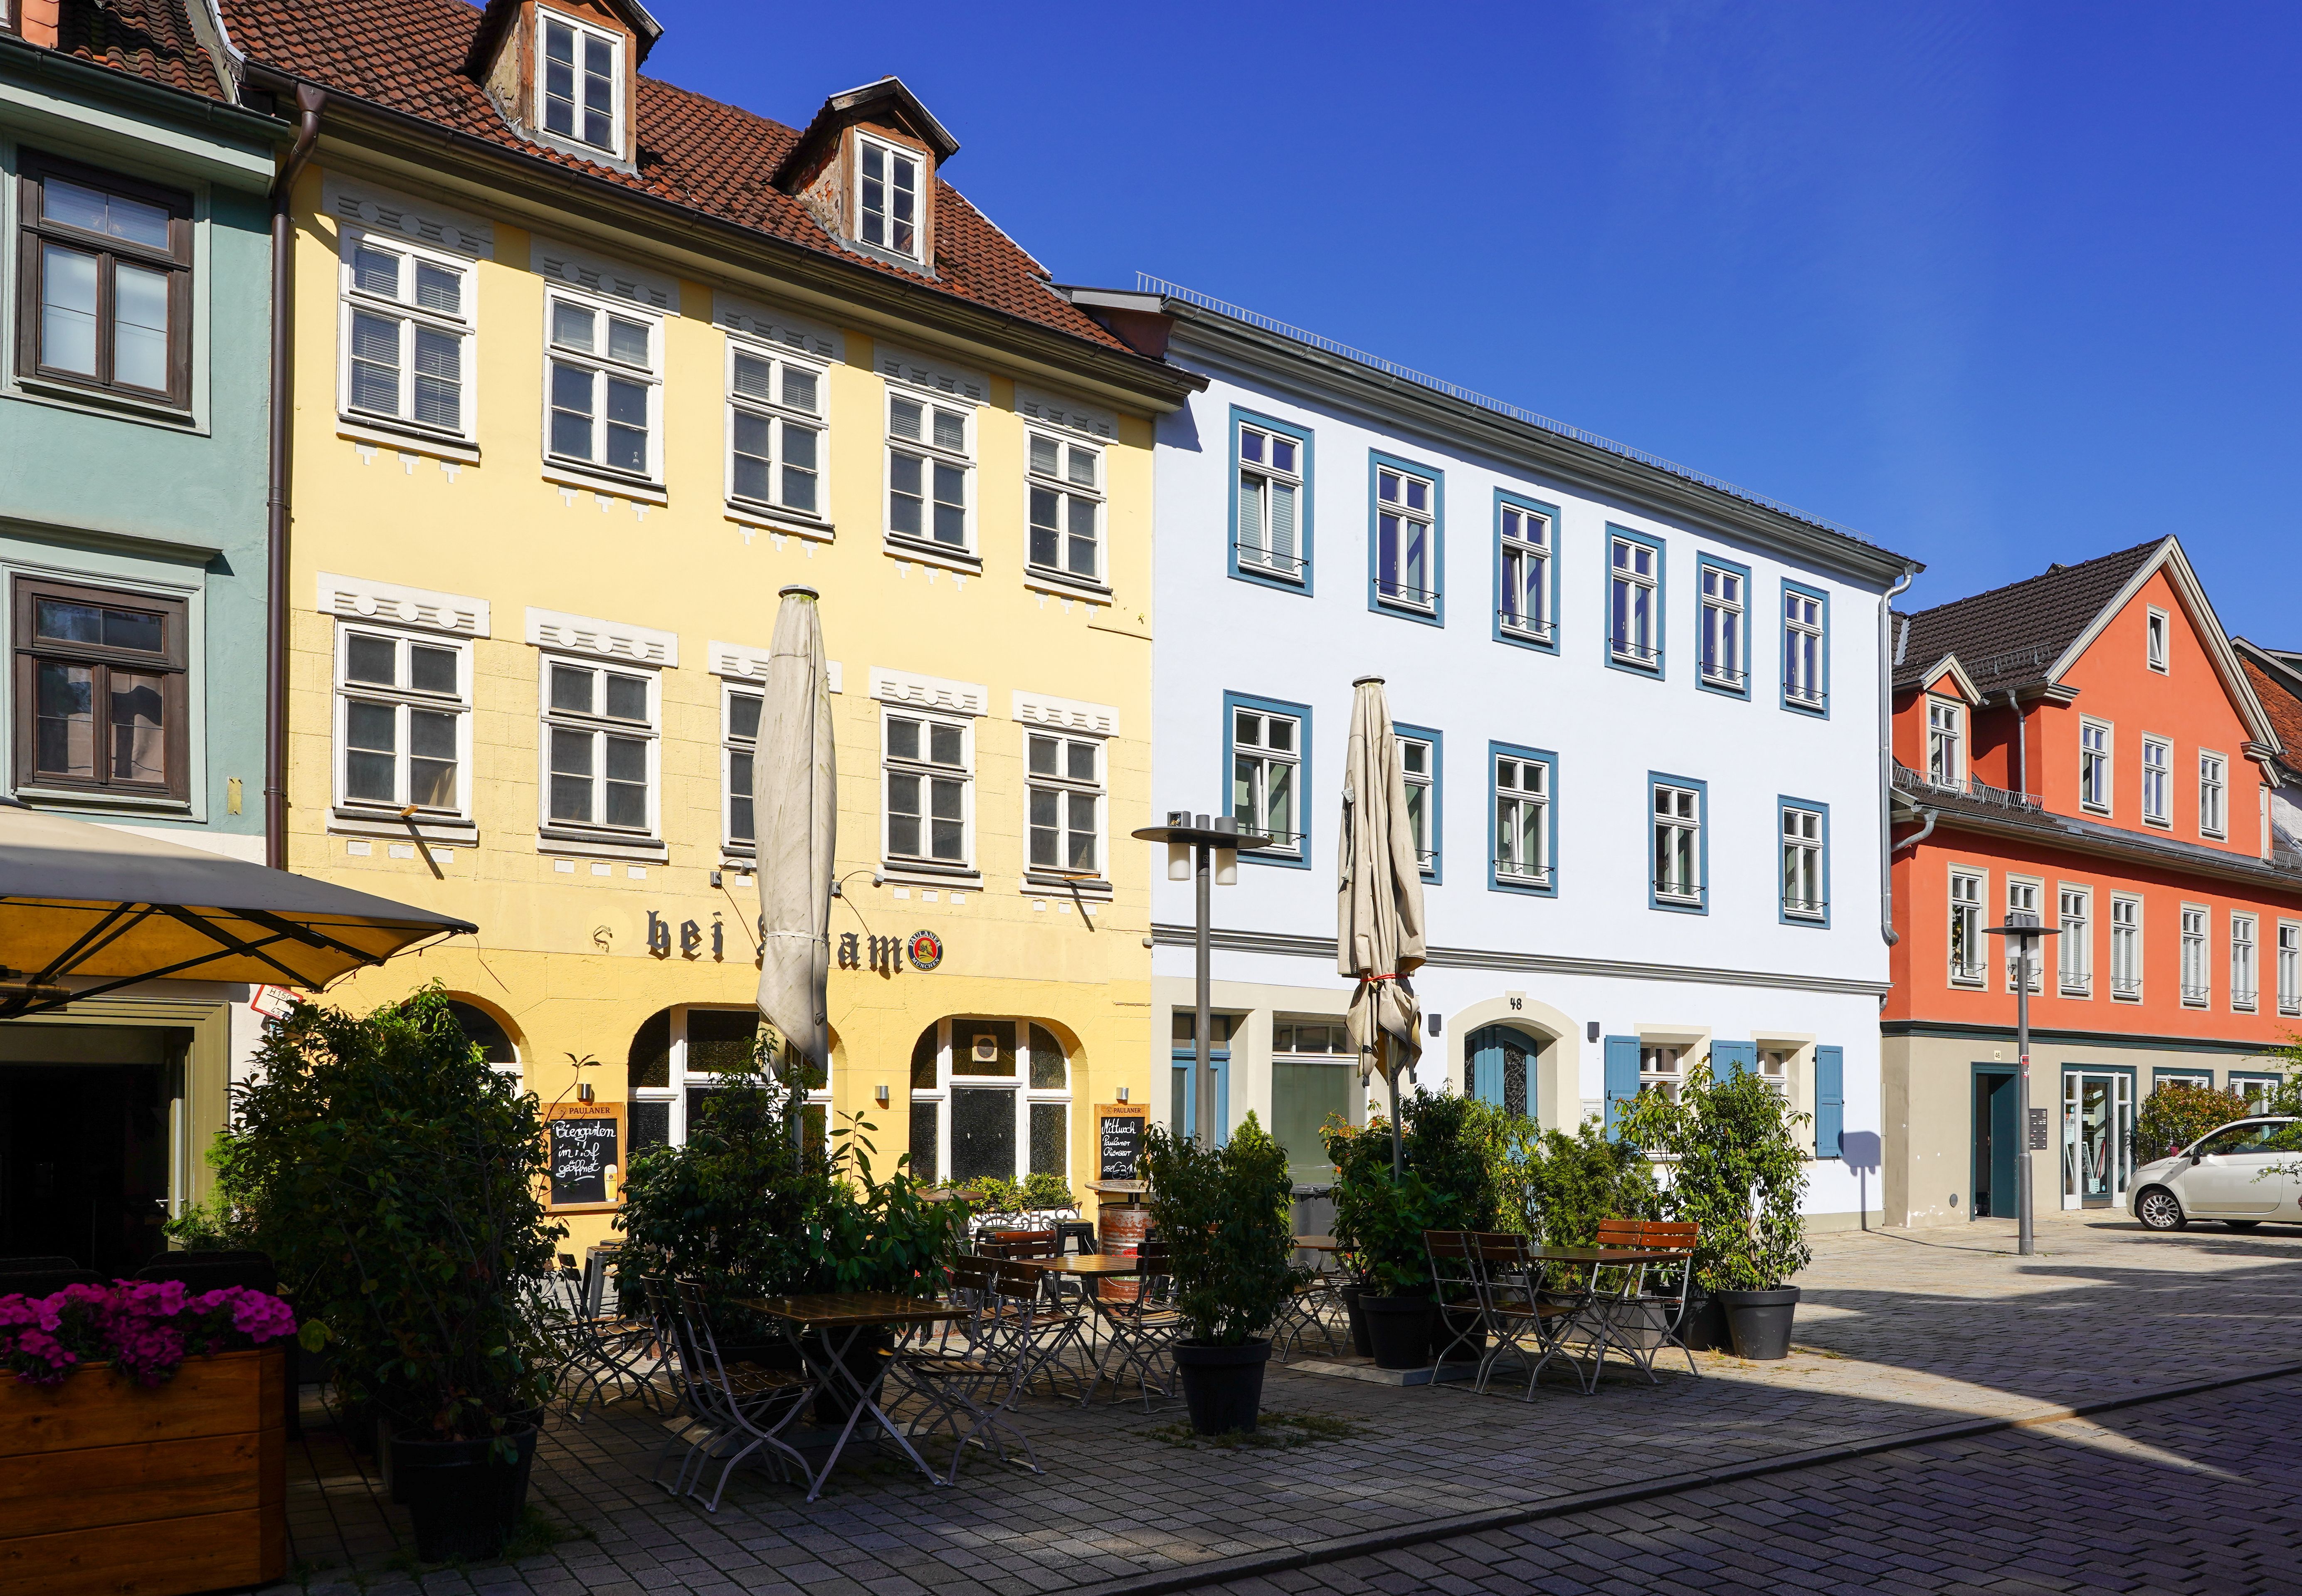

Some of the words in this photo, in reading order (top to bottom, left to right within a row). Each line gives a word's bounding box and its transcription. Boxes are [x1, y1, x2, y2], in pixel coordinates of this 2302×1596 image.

[646, 910, 722, 954] bei
[908, 931, 941, 947] PAULANER
[911, 957, 940, 969] MÜNCHEN
[1510, 997, 1522, 1011] 48
[553, 1120, 617, 1142] Biergarten
[1101, 1118, 1137, 1135] Mittwoch
[1102, 1135, 1131, 1146] Paulaner
[558, 1144, 574, 1158] im
[555, 1159, 601, 1178] geöffnet
